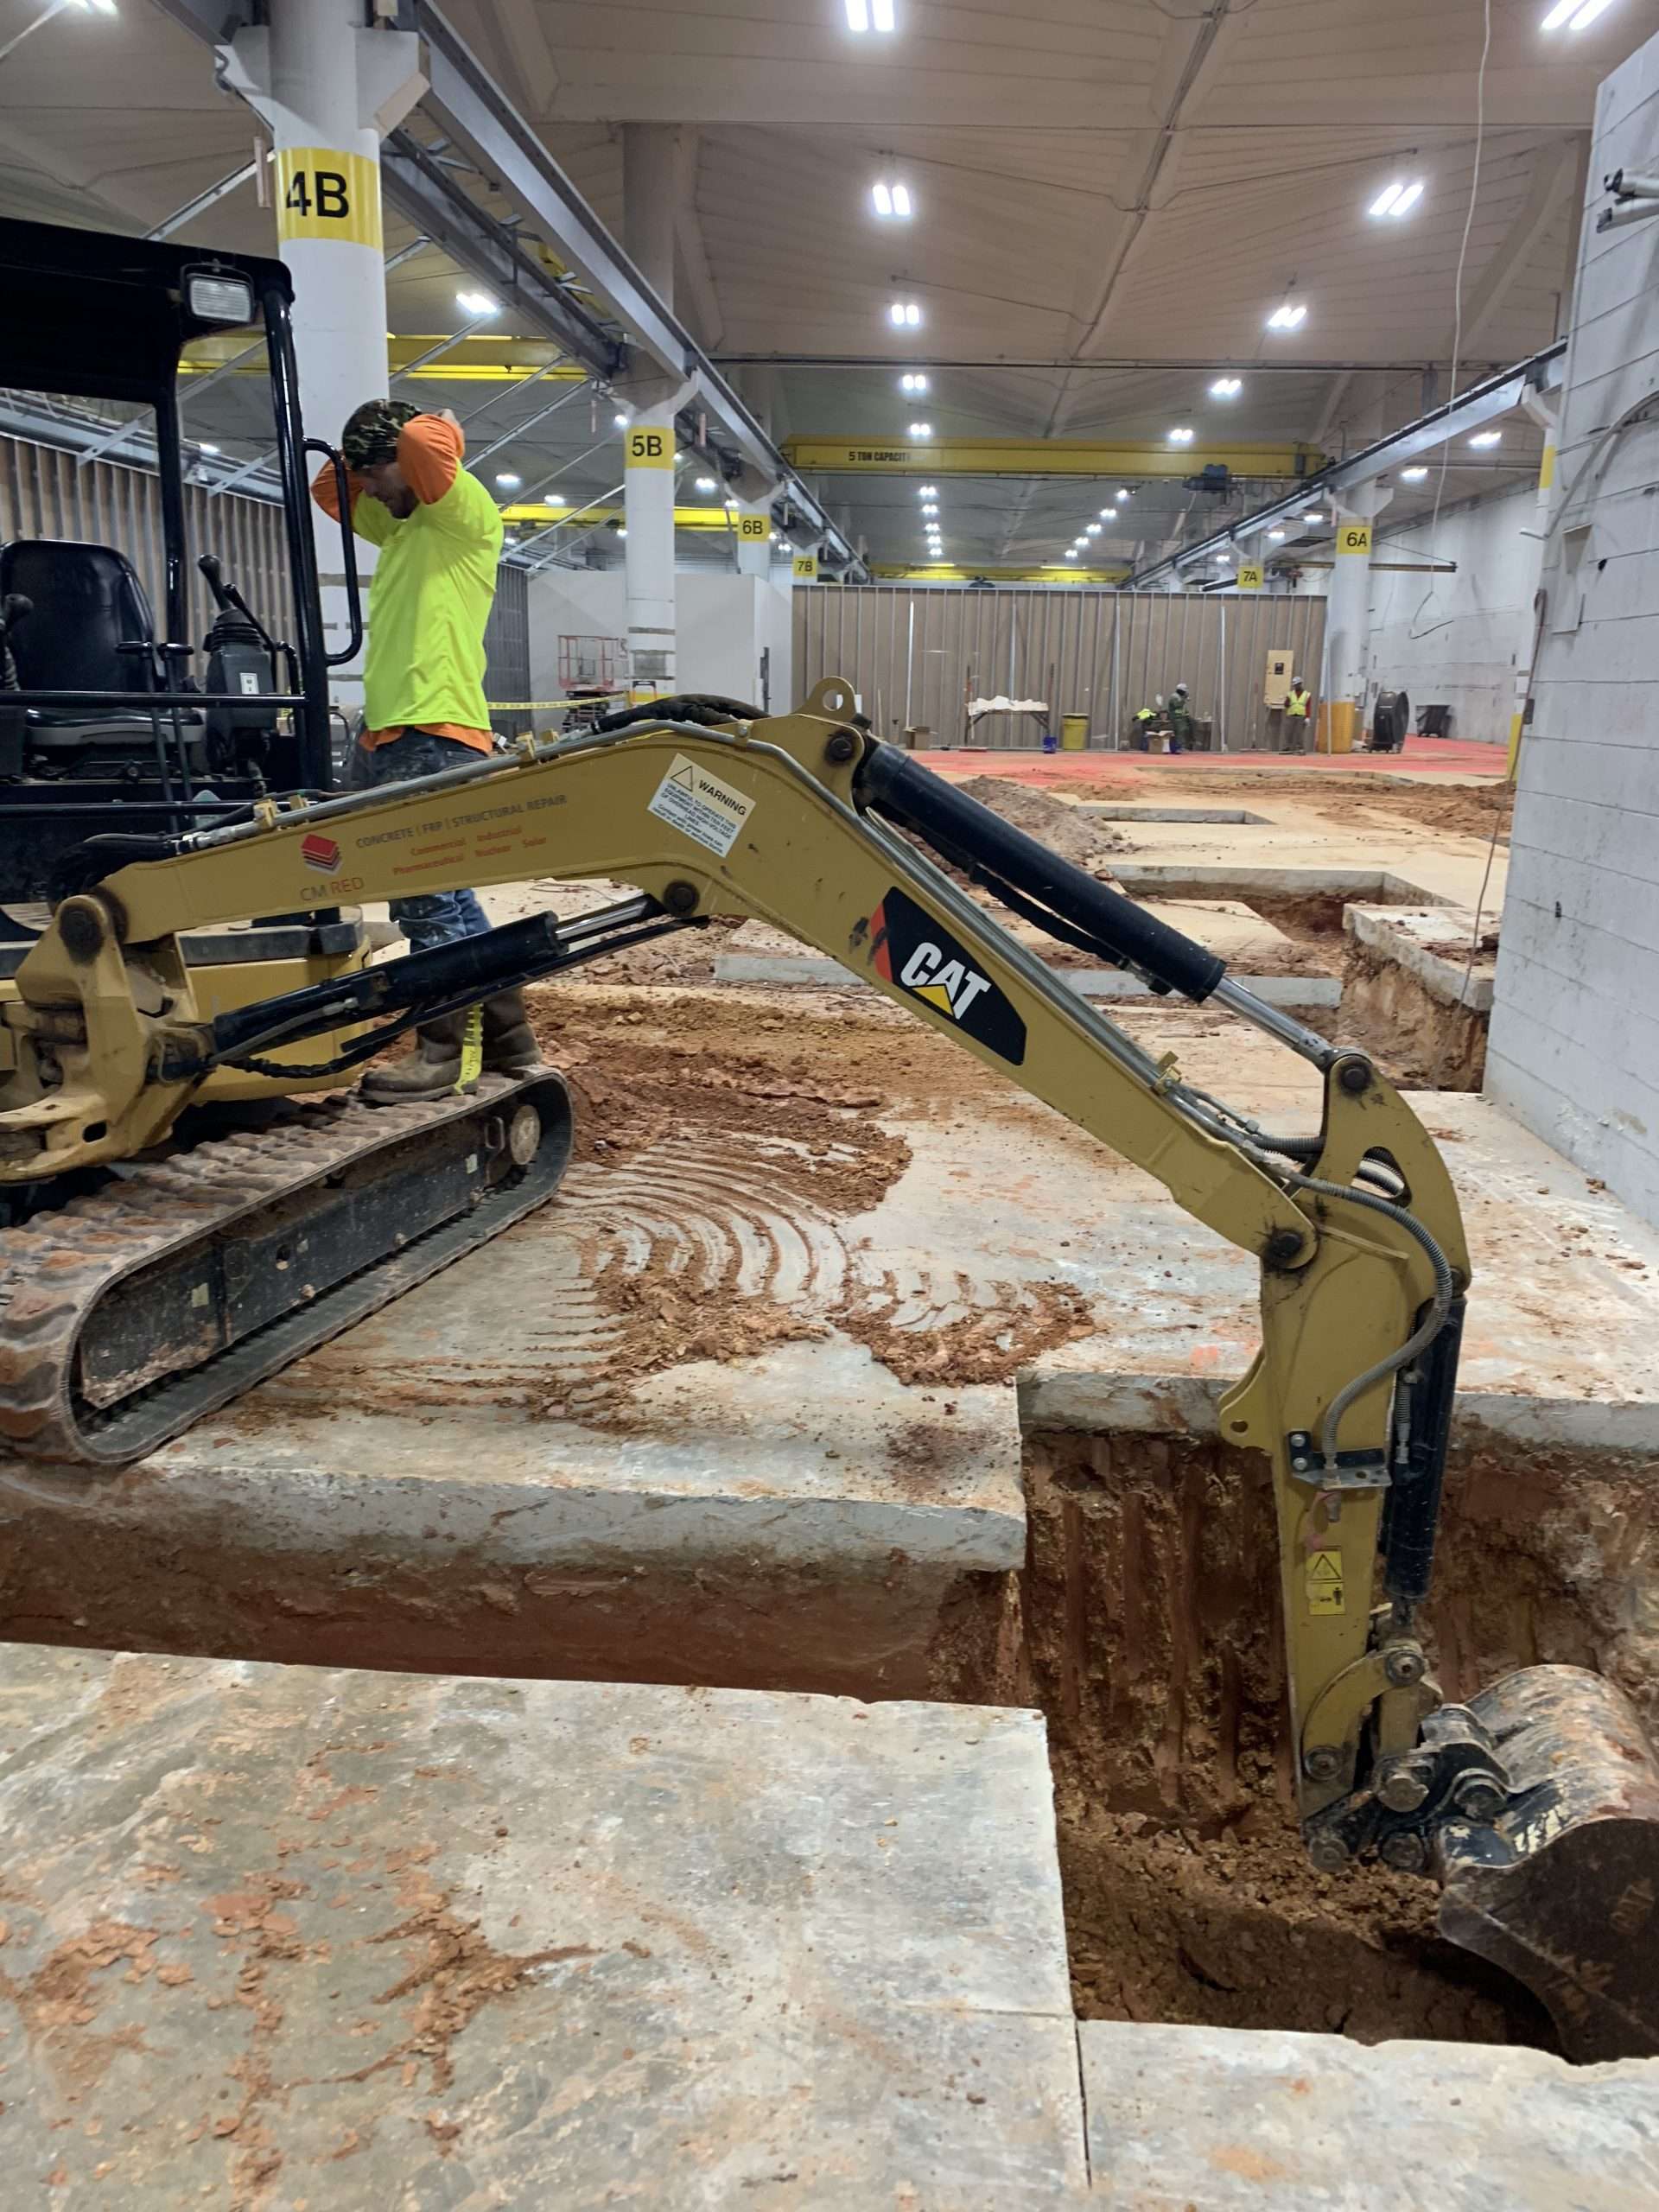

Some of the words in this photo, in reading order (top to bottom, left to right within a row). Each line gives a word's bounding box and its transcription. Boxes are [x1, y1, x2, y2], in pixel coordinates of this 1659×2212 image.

[286, 171, 350, 219] 4B
[632, 435, 663, 456] 5B
[849, 451, 856, 461] 5
[858, 451, 872, 461] TON
[742, 520, 763, 535] 6B
[1346, 531, 1367, 547] 6A
[798, 561, 812, 571] 7B
[1243, 570, 1257, 582] 7A
[698, 779, 747, 816] WARNING
[356, 828, 414, 848] CONCRETE
[452, 804, 524, 827] STRUCTURAL
[526, 795, 567, 810] REPAIR
[301, 884, 327, 900] CM
[330, 877, 364, 894] RED
[900, 942, 992, 1020] CAT
